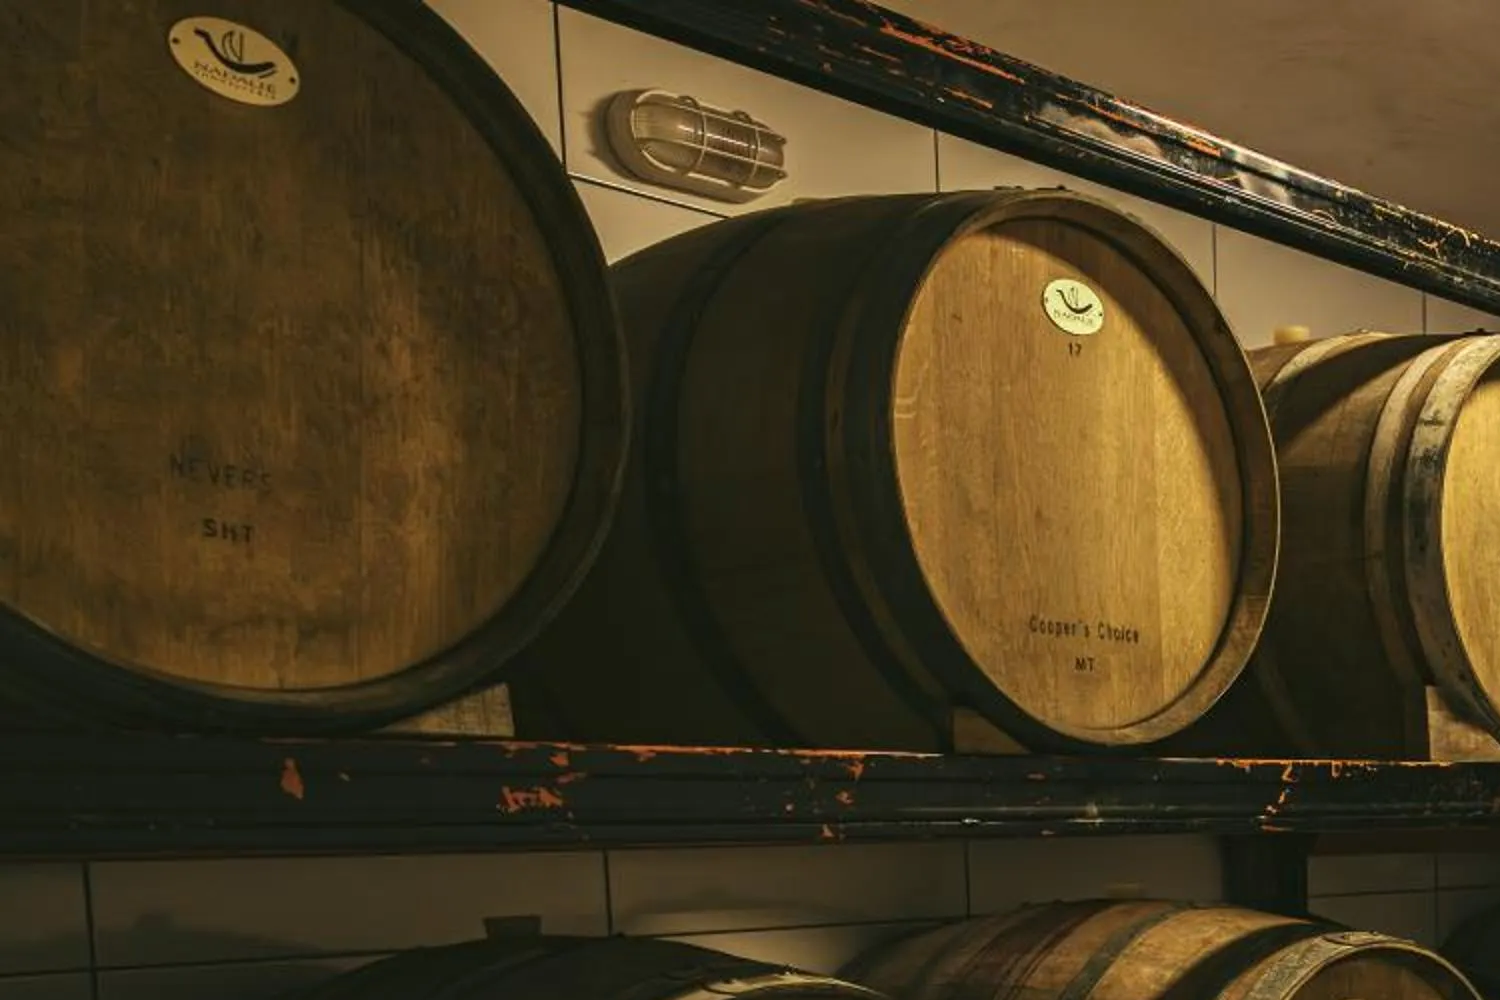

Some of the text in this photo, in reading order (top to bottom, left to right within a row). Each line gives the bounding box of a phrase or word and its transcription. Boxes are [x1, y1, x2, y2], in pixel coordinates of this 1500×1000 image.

[1029, 614, 1139, 644] Cooper's Choice
[1075, 657, 1095, 672] MT
